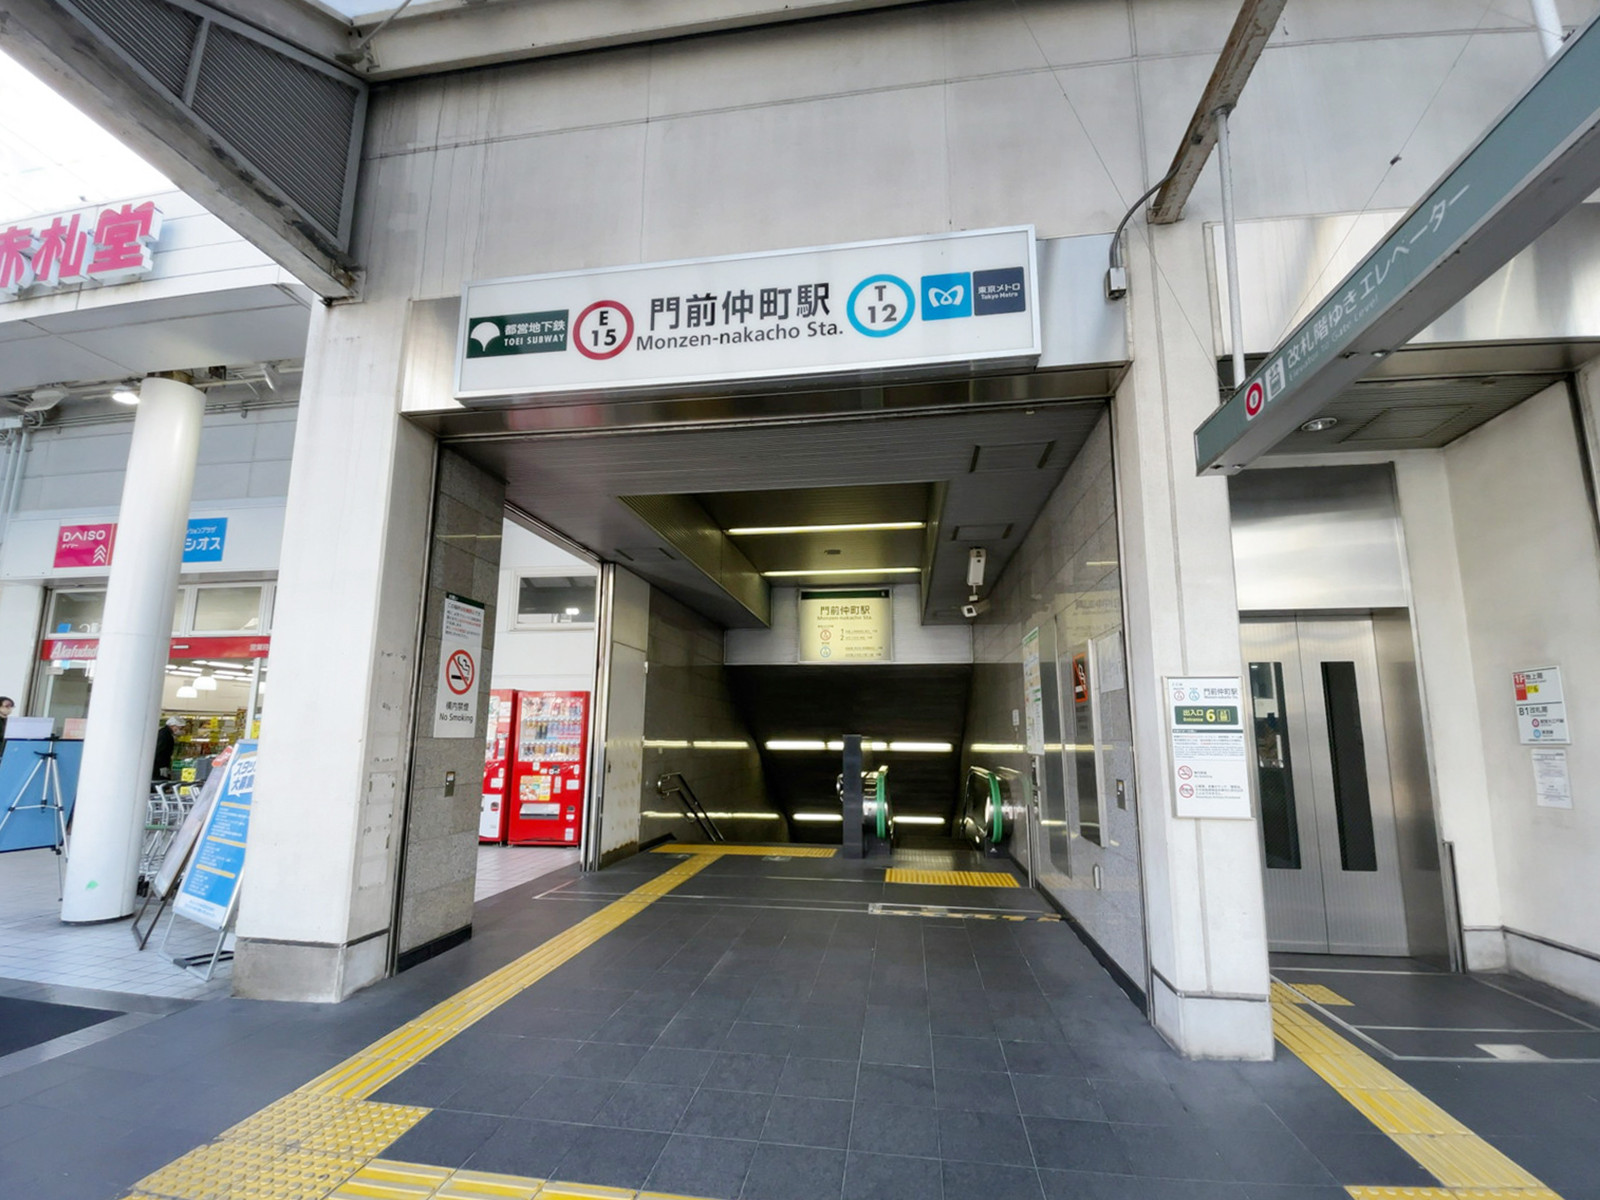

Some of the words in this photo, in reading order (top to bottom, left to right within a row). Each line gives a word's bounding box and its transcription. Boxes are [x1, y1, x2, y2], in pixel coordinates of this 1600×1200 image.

[1287, 184, 1470, 369] 改札階ゆきエレベーター
[874, 285, 887, 302] T
[978, 282, 1021, 295] 東京メトロ
[980, 292, 1000, 301] Tokyo
[1000, 291, 1019, 299] Metro
[649, 282, 831, 331] 門前仲町駅
[868, 304, 897, 323] 12
[598, 310, 609, 326] E
[504, 319, 566, 336] 都営地下鉄
[504, 338, 524, 347] TOEI
[527, 334, 565, 345] SUBWAY
[591, 329, 617, 347] 15
[636, 324, 800, 352] Monzen-nakacho
[807, 321, 843, 338] Sta.
[63, 530, 106, 542] DAISO
[820, 605, 871, 616] 門前仲町駅
[449, 713, 474, 724] Smoking
[1183, 709, 1204, 717] 出入口
[1206, 709, 1216, 722] 6
